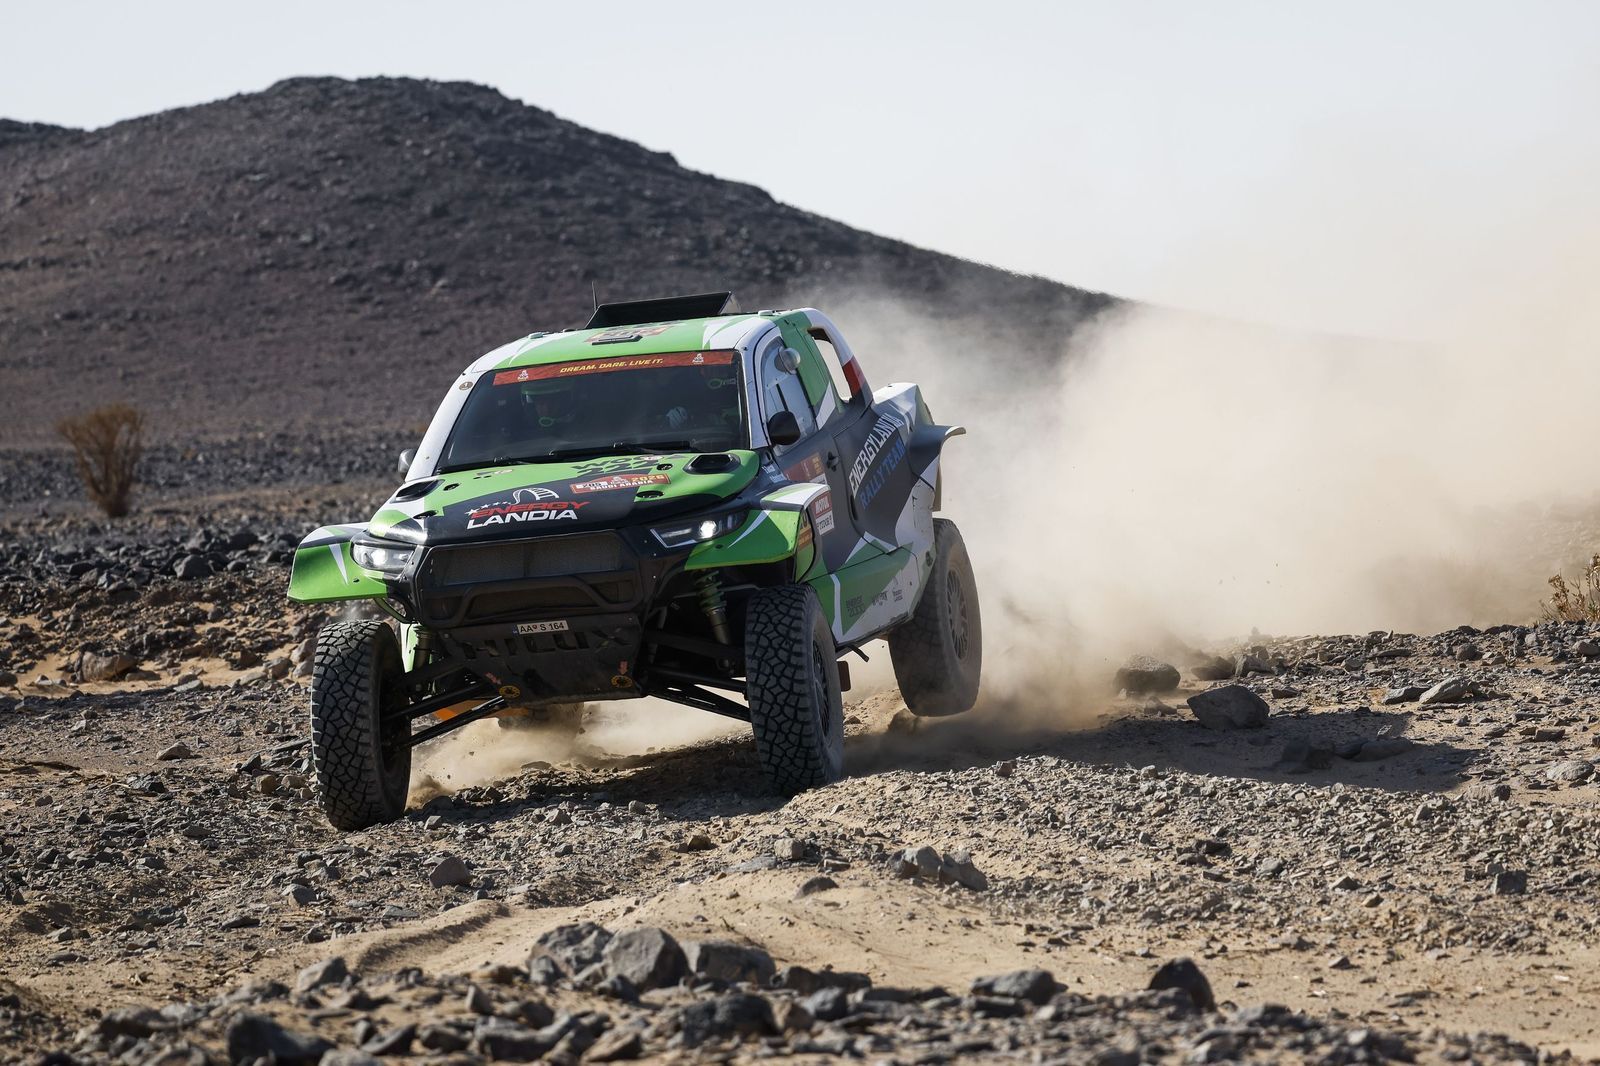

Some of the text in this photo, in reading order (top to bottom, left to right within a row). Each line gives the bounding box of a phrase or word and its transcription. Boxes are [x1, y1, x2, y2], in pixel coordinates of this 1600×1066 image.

[560, 364, 597, 373] DREAM.
[598, 361, 628, 370] DARE.
[629, 359, 651, 367] LIVE
[631, 474, 665, 482] 2026
[860, 438, 907, 510] RALLY TEAM
[590, 483, 618, 491] SAUDI
[620, 480, 654, 489] ARABIA
[470, 501, 590, 519] ENERGY
[467, 509, 578, 530] LANDIA
[519, 621, 565, 633] AA S 164
